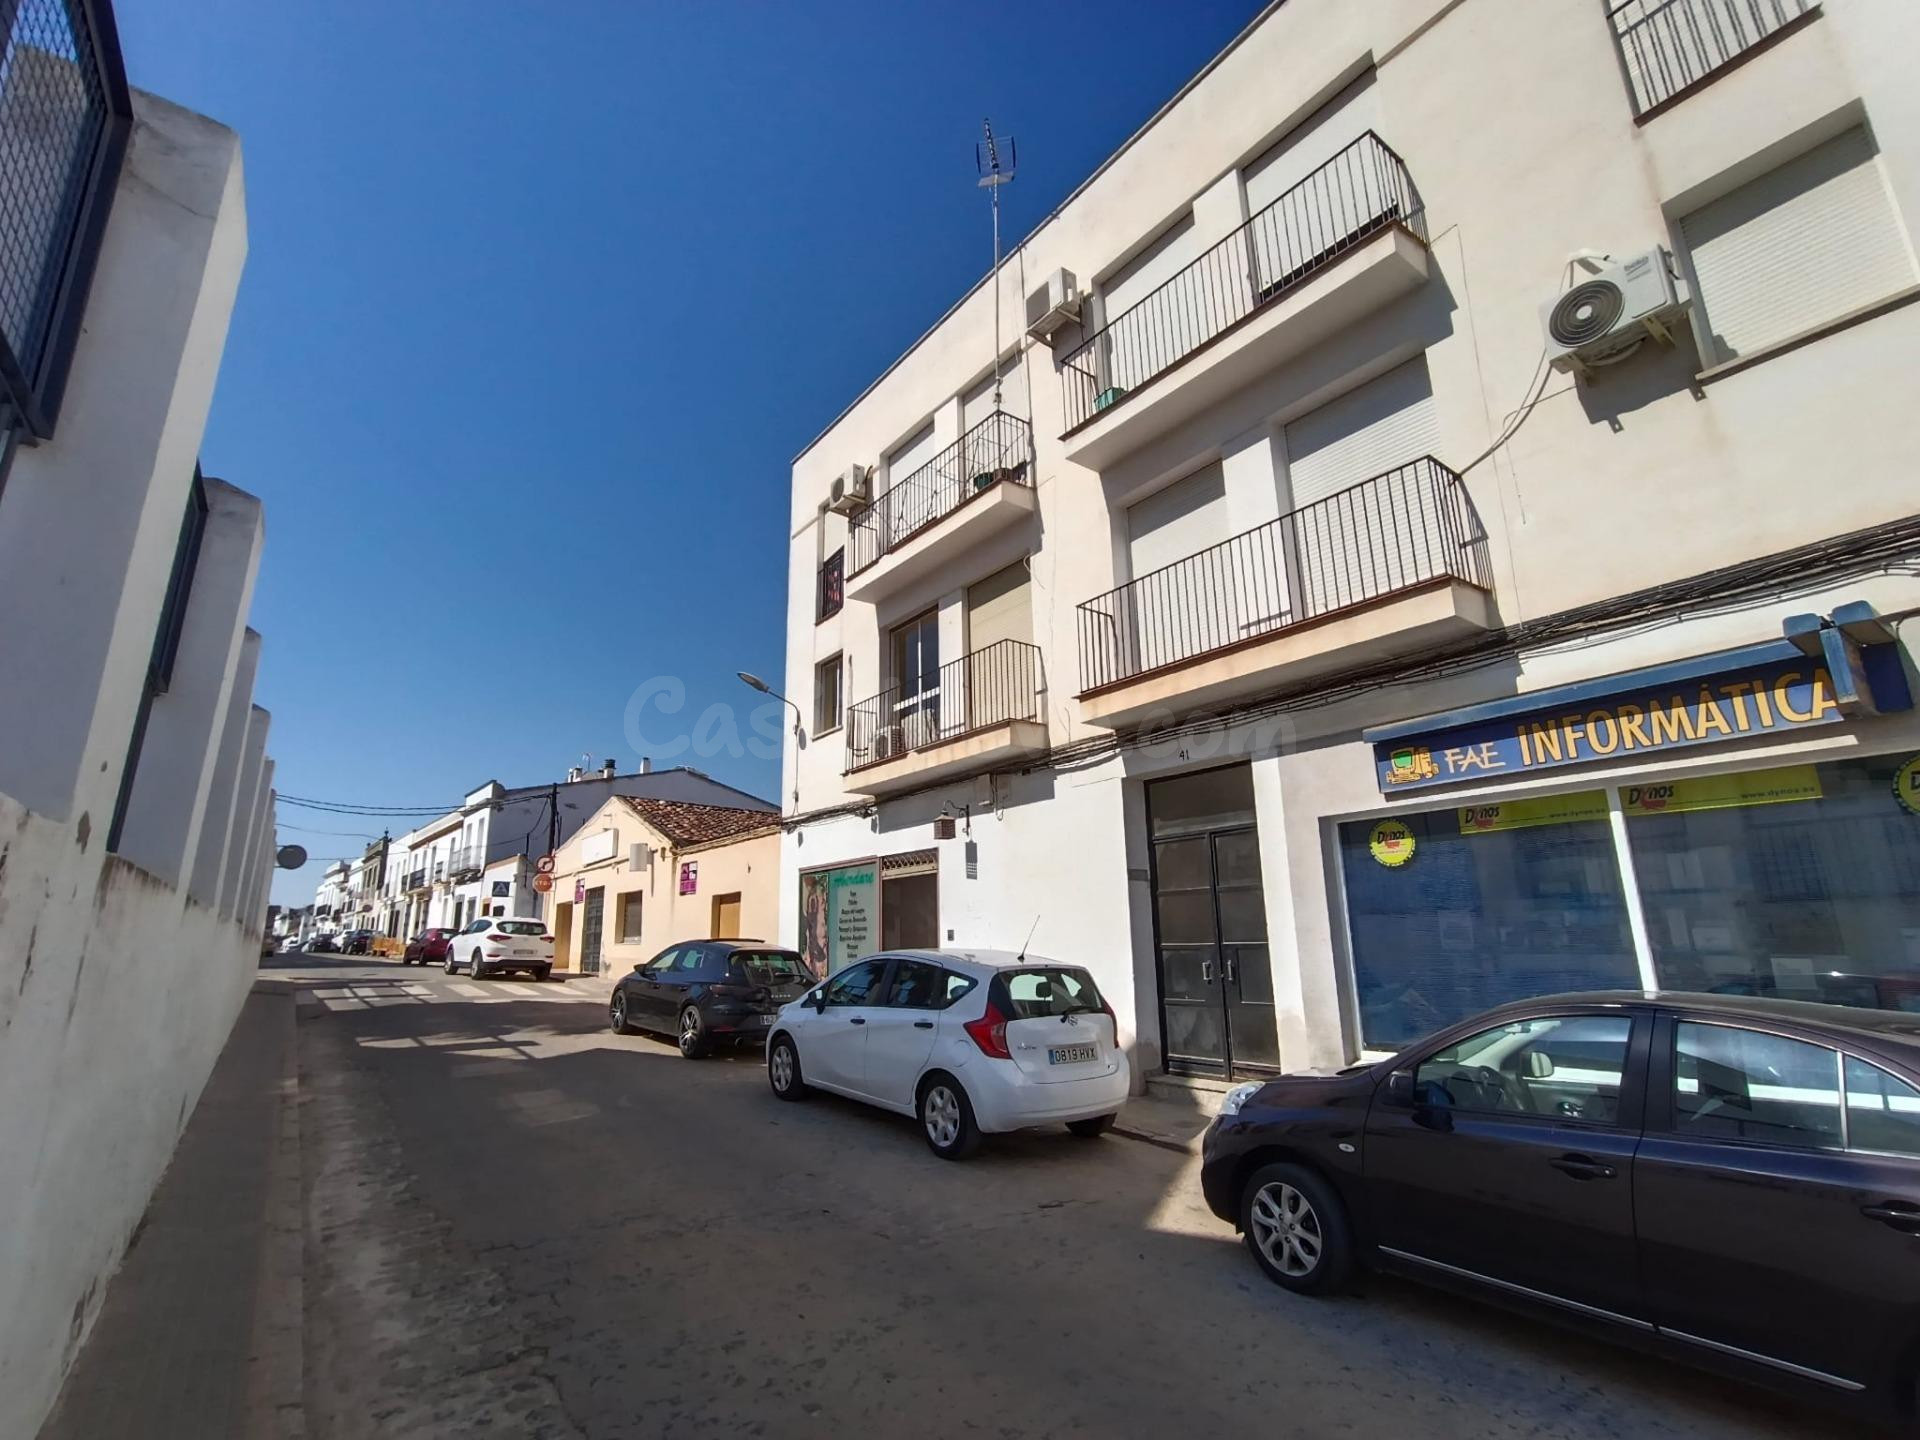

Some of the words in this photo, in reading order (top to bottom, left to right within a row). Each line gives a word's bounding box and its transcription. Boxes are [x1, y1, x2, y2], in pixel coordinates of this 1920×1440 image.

[1178, 749, 1190, 761] 41
[1443, 742, 1506, 774] FAE
[1055, 1050, 1078, 1062] 0819
